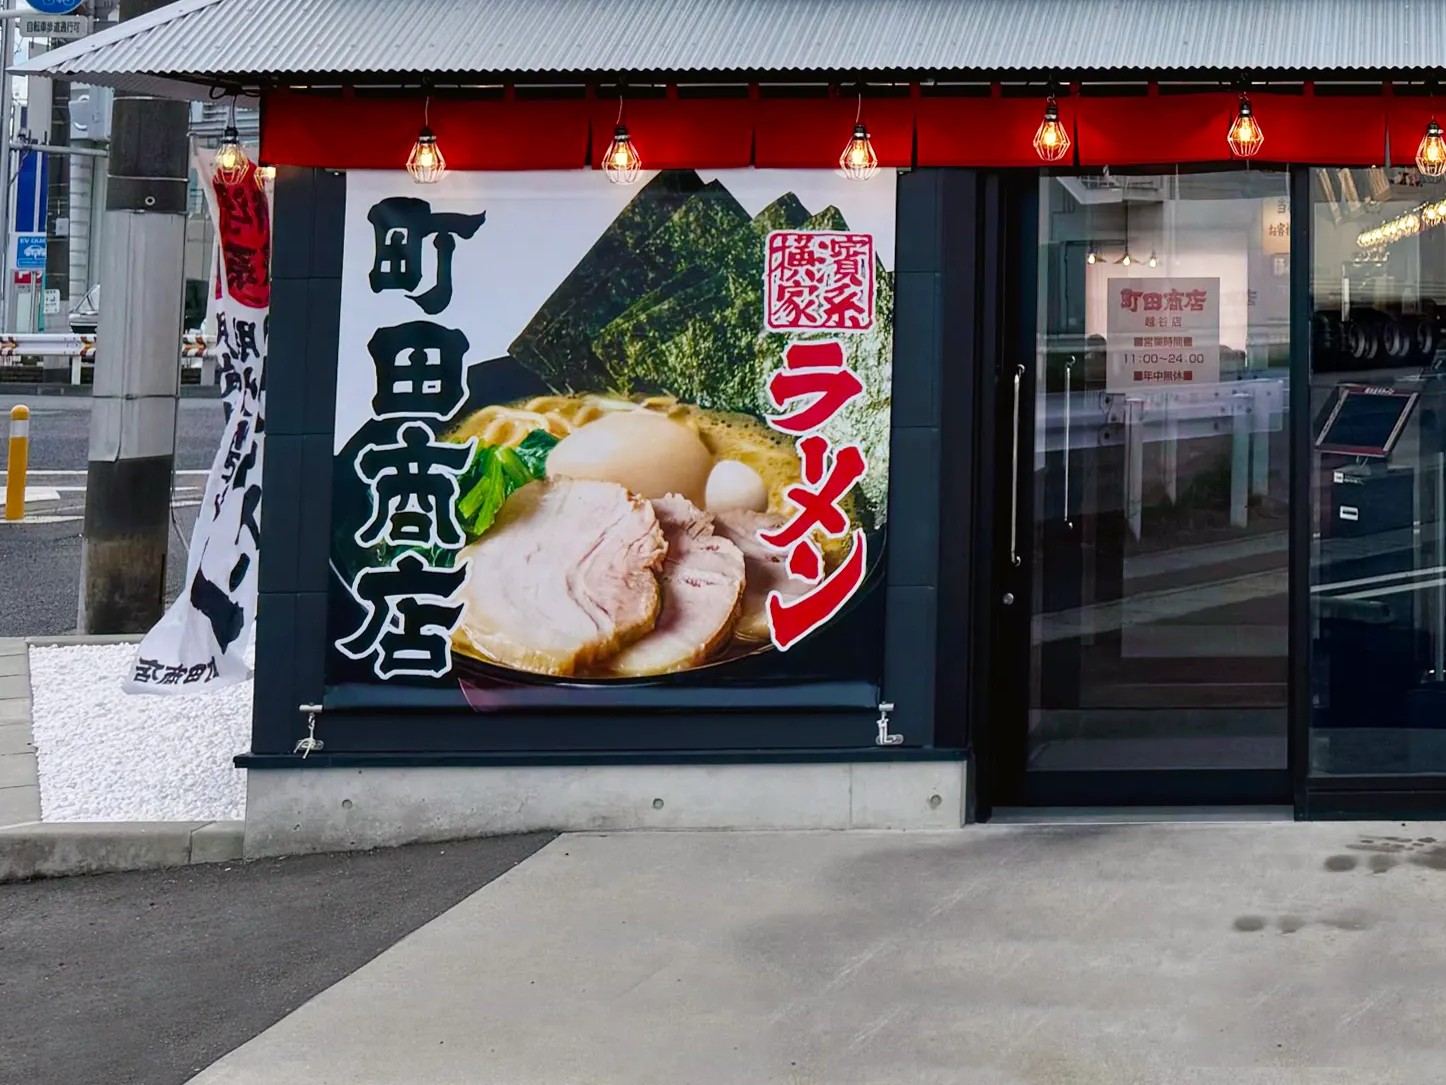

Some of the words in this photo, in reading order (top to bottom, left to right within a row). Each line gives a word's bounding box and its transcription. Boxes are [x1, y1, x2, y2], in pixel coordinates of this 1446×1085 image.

[1120, 288, 1207, 313] 町田商店
[1144, 316, 1182, 328] 越谷店
[335, 196, 487, 681] 町田商店
[757, 340, 868, 652] ラーメン
